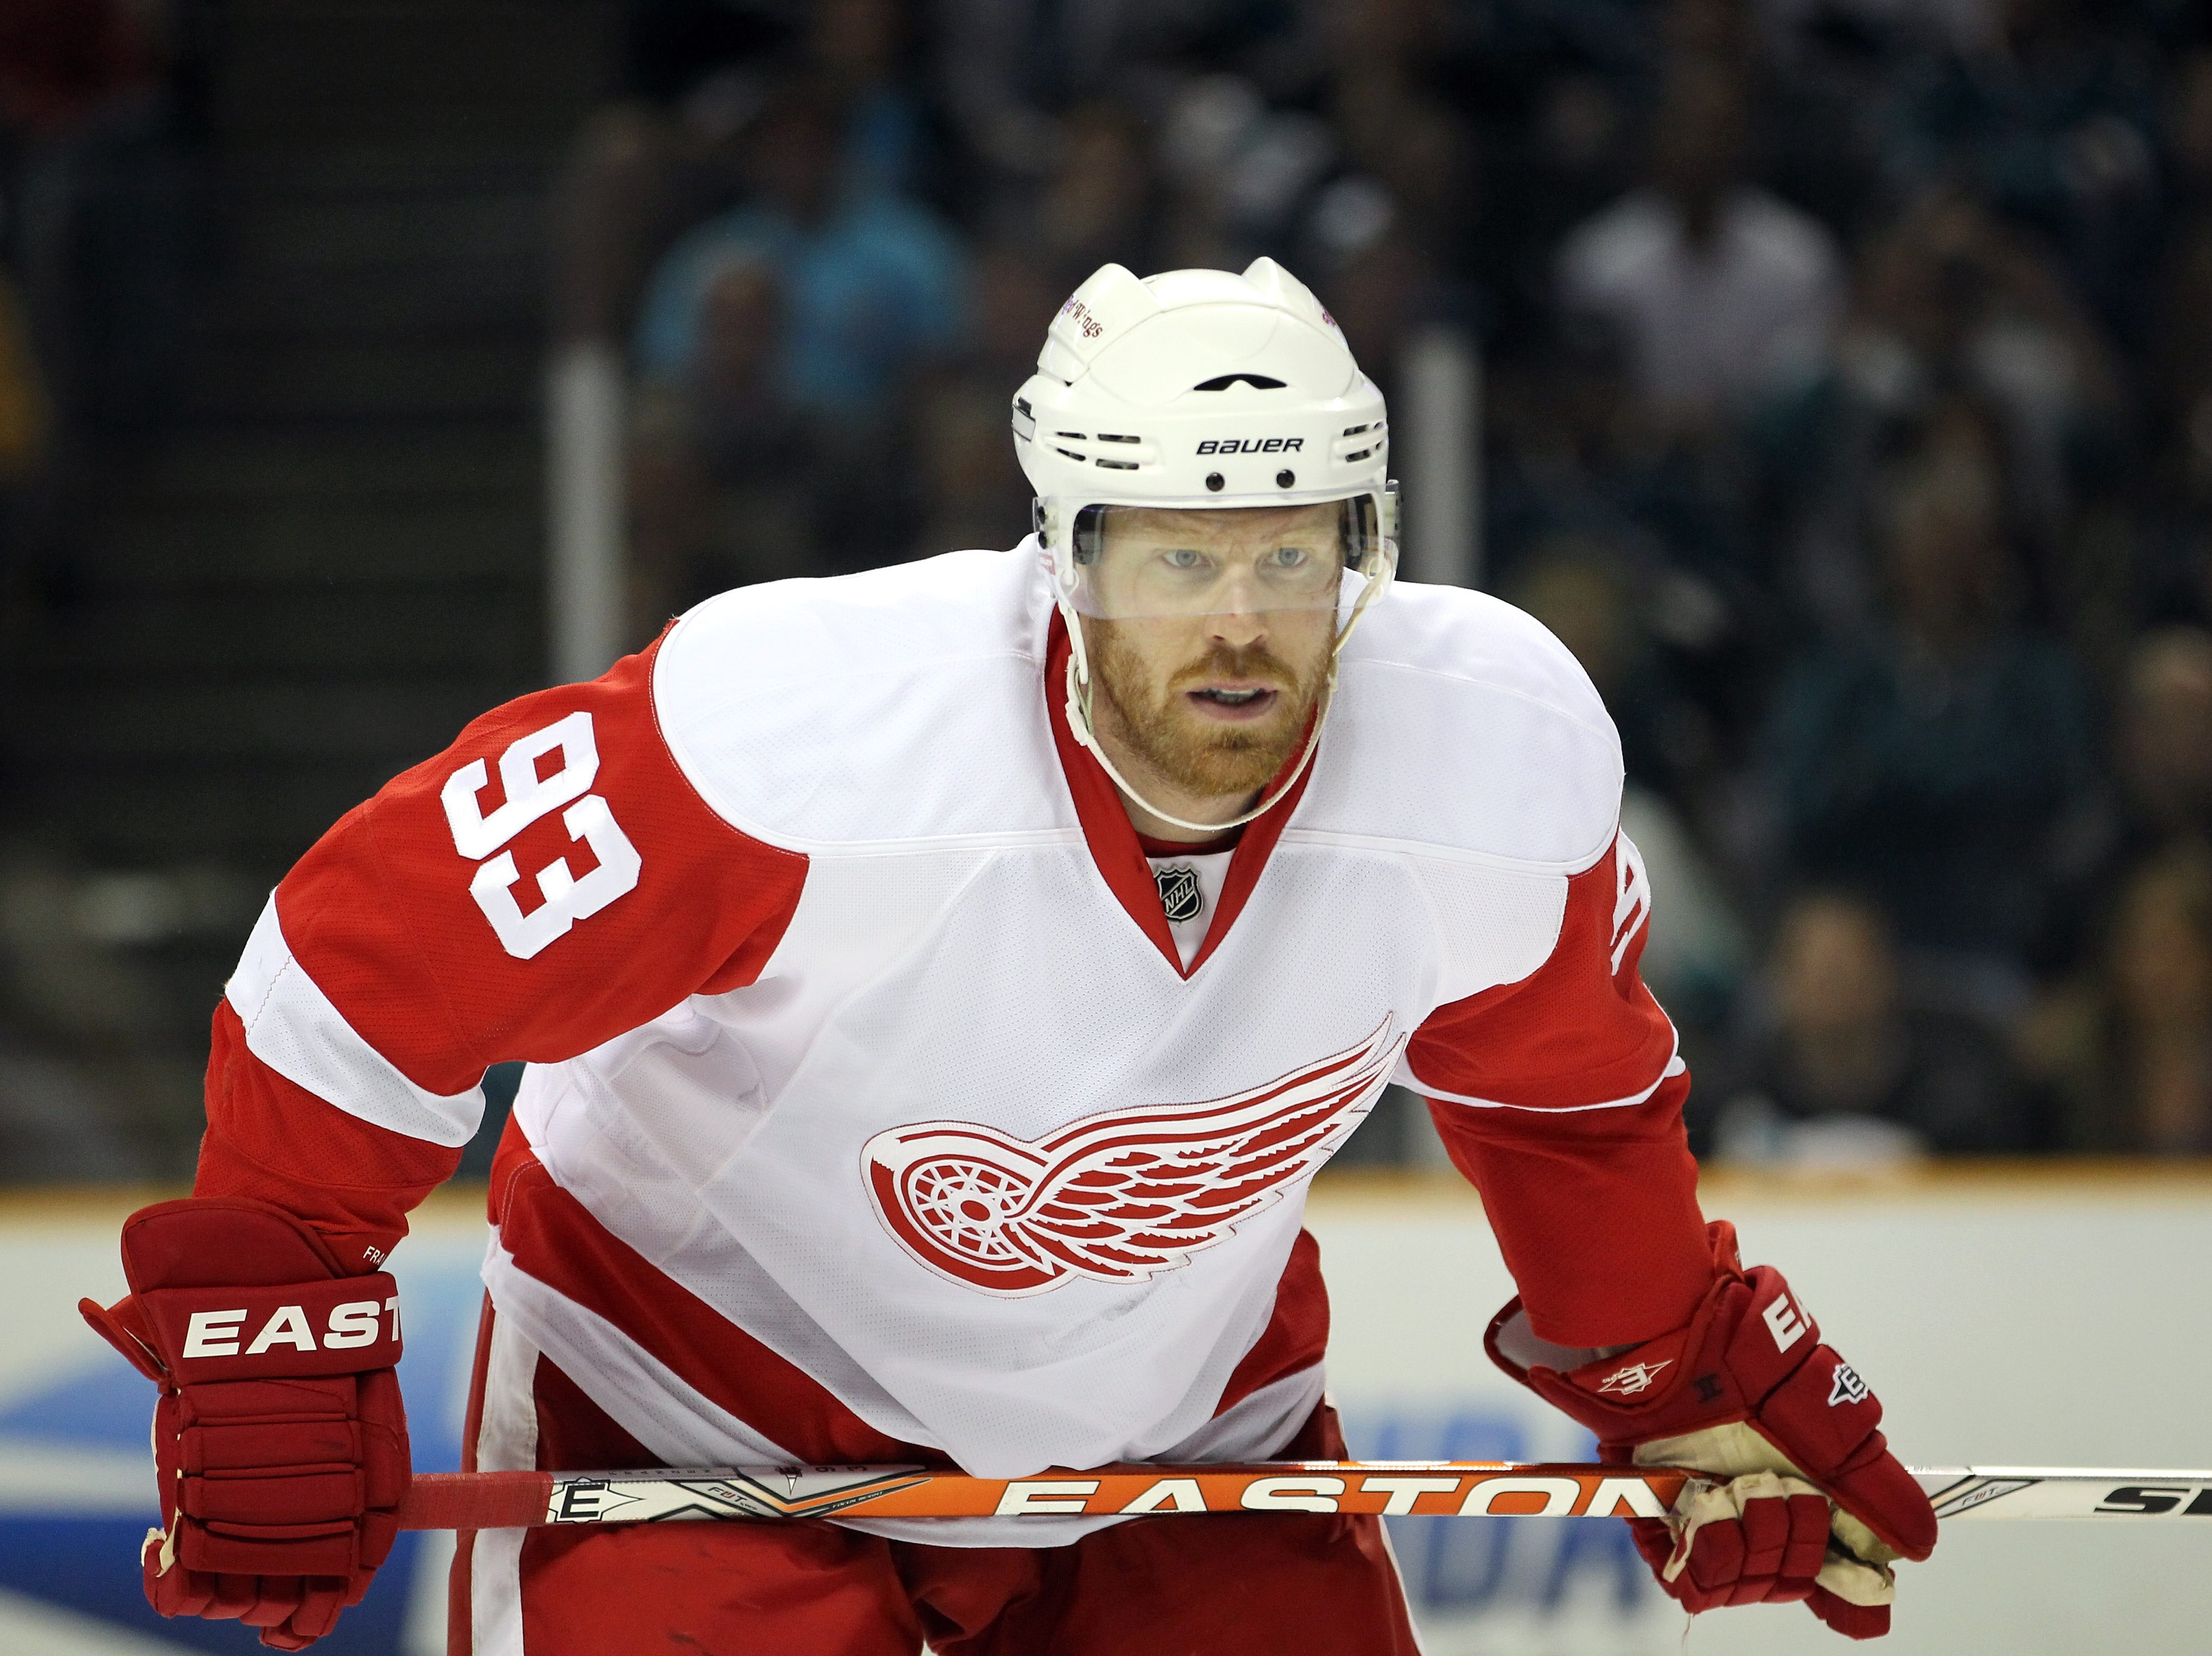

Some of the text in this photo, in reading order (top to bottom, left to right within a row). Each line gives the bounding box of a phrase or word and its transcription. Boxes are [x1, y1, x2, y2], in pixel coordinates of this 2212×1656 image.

[440, 711, 643, 960] 93
[1164, 880, 1193, 913] NHL
[993, 1477, 1669, 1517] EASTON
